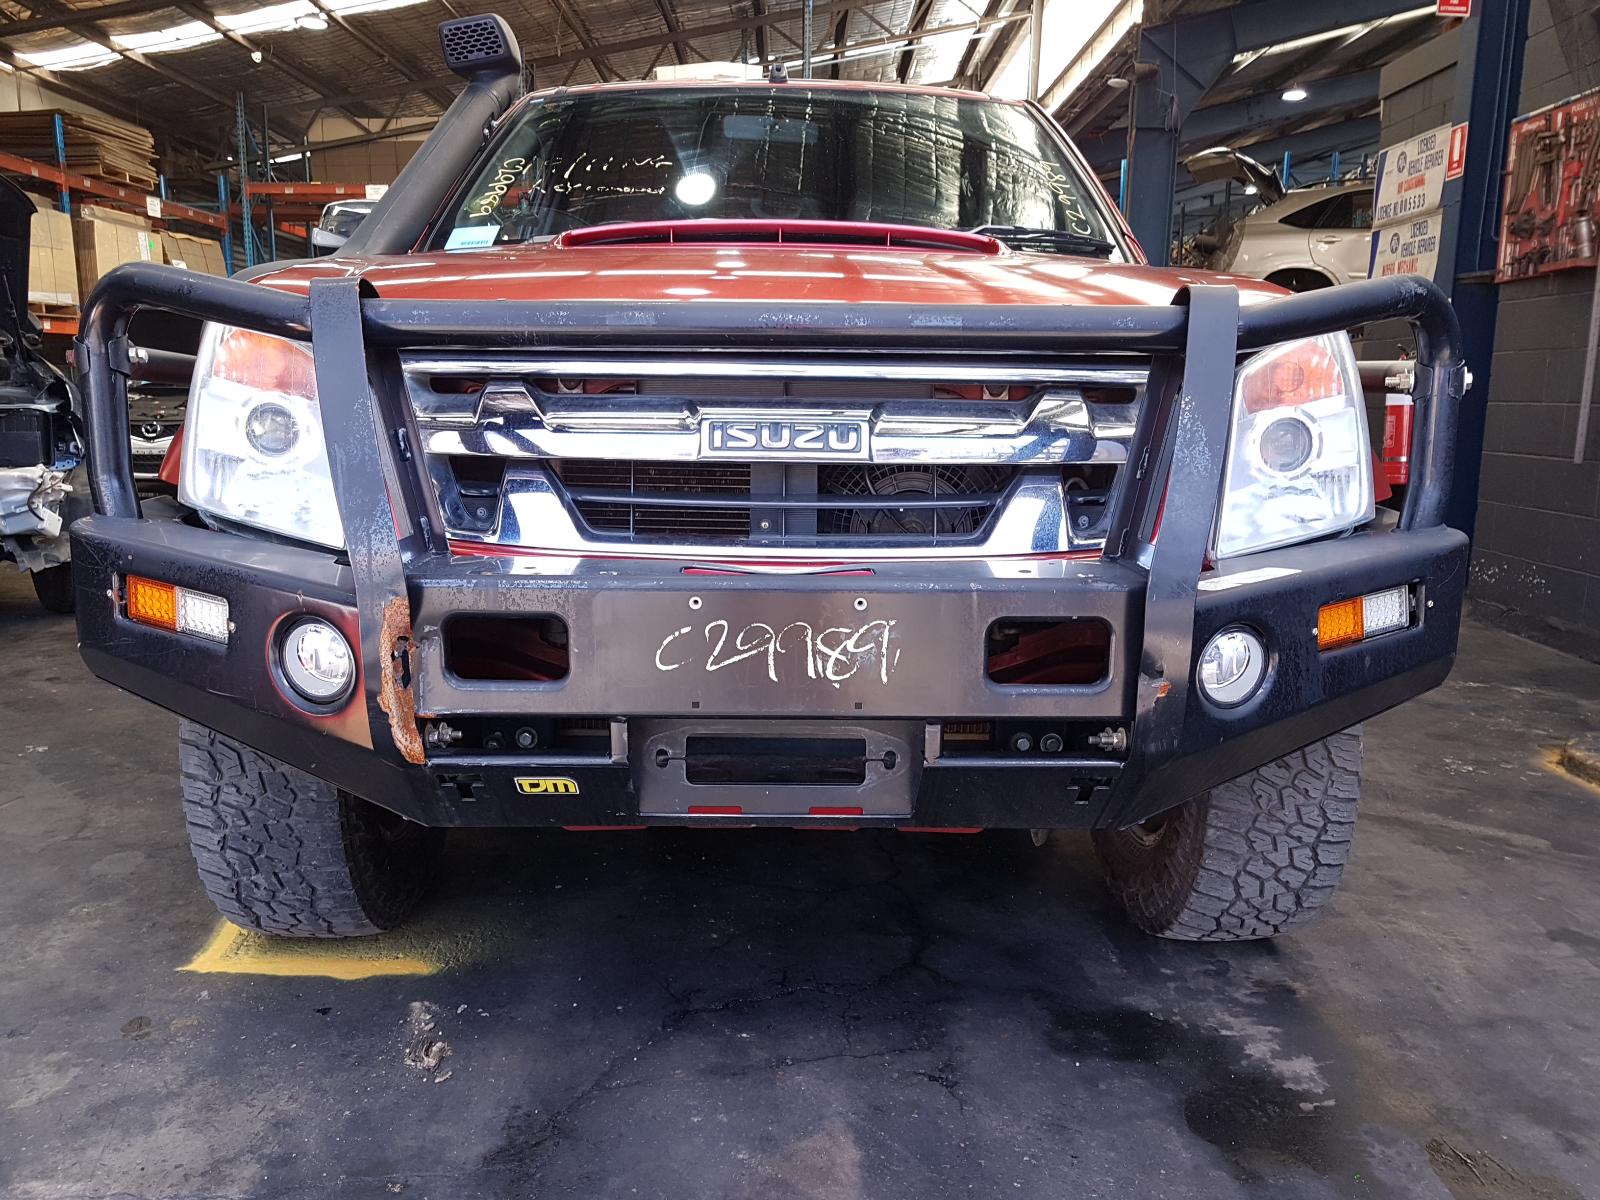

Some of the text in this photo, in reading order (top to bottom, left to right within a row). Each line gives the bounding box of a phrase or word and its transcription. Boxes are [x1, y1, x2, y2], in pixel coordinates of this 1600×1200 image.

[1418, 134, 1437, 155] LICENSED
[1408, 149, 1444, 176] VEHICLE REPAIRER
[1410, 220, 1428, 239] LICENSED
[711, 422, 859, 449] ISUZU
